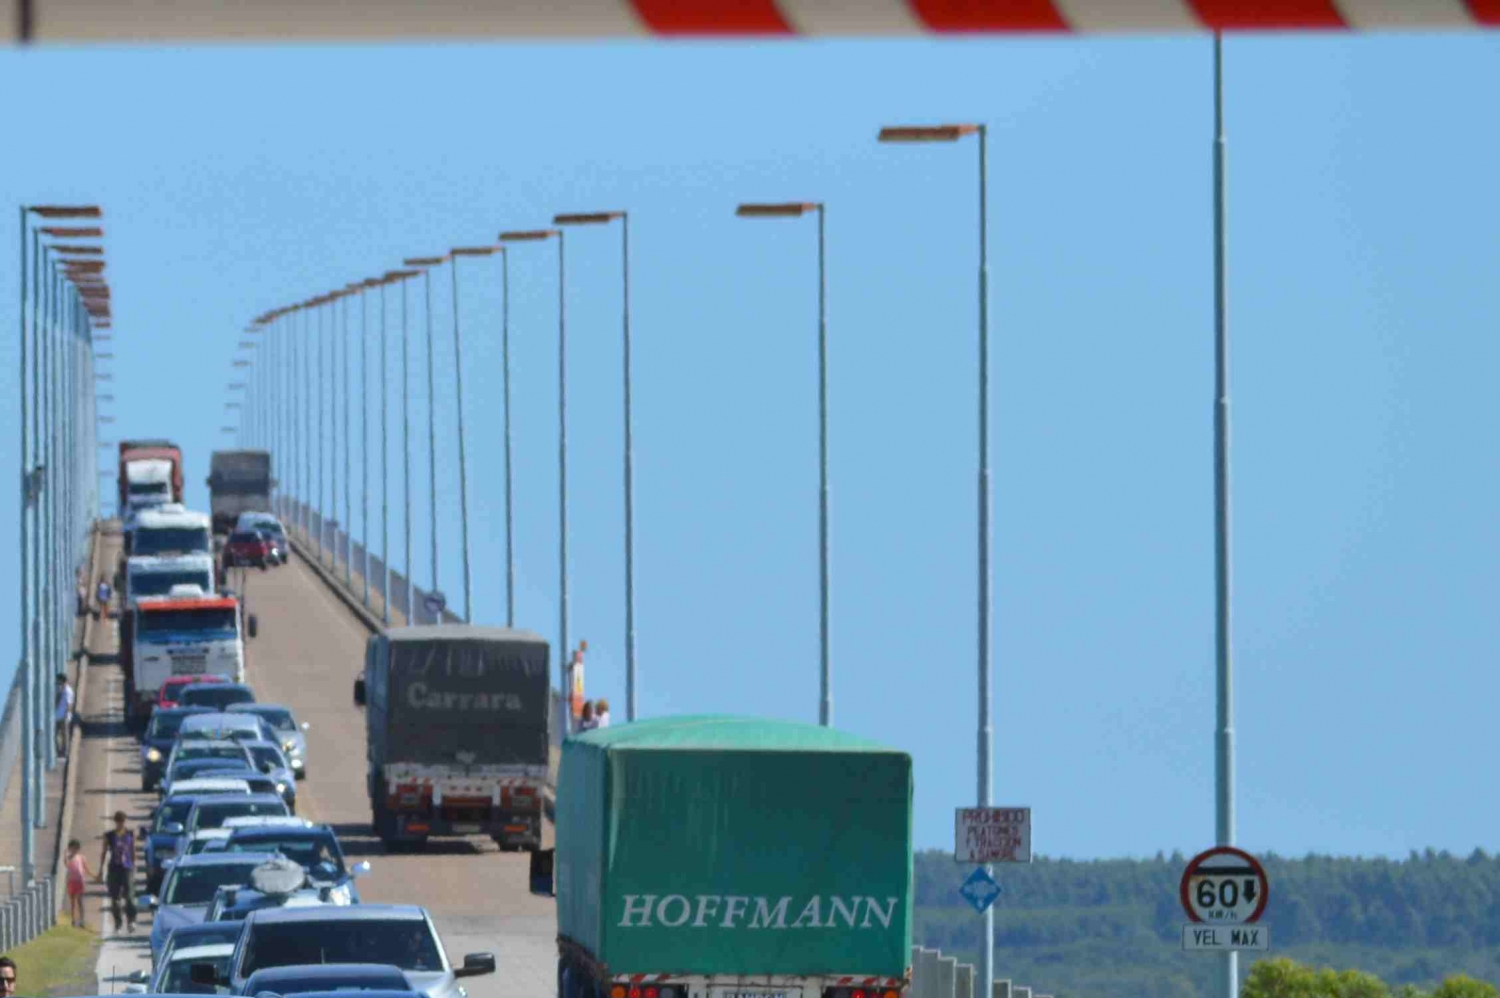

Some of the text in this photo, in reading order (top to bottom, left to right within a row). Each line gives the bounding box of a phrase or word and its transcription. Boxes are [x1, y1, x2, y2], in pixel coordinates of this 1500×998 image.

[407, 682, 522, 710] Carrara
[1197, 880, 1238, 908] 60
[617, 894, 898, 929] HOFFMANN
[1194, 929, 1259, 945] VEL MAX
